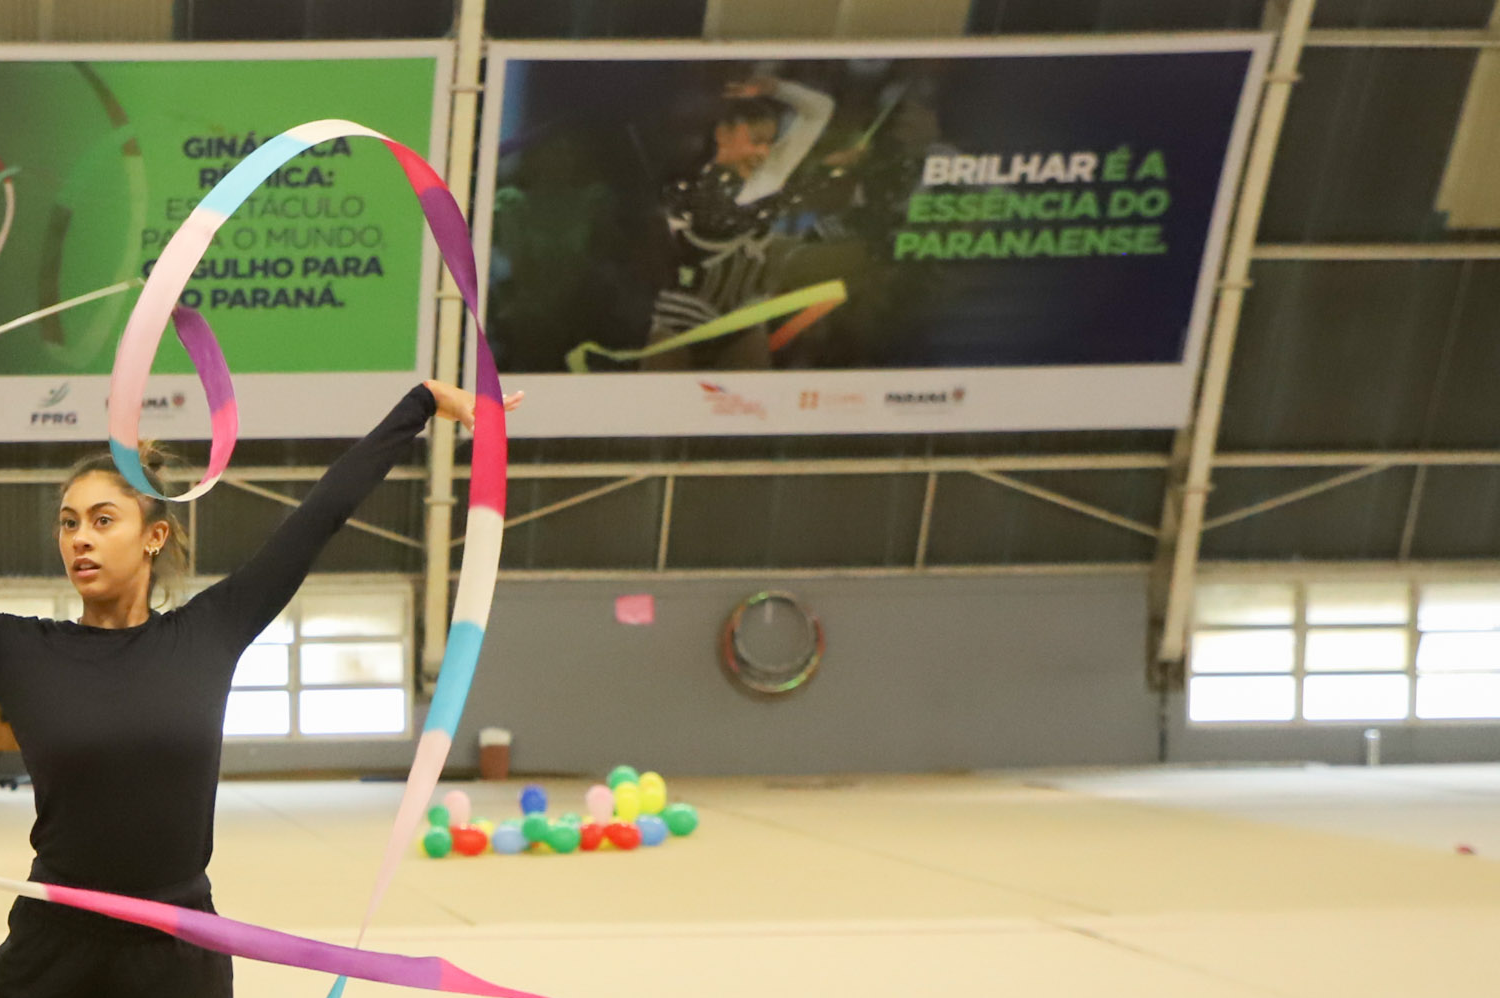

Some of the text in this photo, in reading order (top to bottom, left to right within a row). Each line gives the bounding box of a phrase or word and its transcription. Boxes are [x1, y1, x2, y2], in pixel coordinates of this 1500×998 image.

[183, 131, 351, 159] GINÁCA
[922, 145, 1167, 185] BRILHAR É A
[166, 194, 365, 220] ETÁCULO
[907, 187, 1170, 223] ESSÊNCIA DO
[141, 229, 223, 250] PAA
[233, 227, 257, 250] O
[894, 225, 1168, 260] PARANAENSE.
[142, 256, 383, 280] GULHO PARA
[211, 282, 345, 309] PARANÁ.
[30, 412, 77, 425] FPRG
